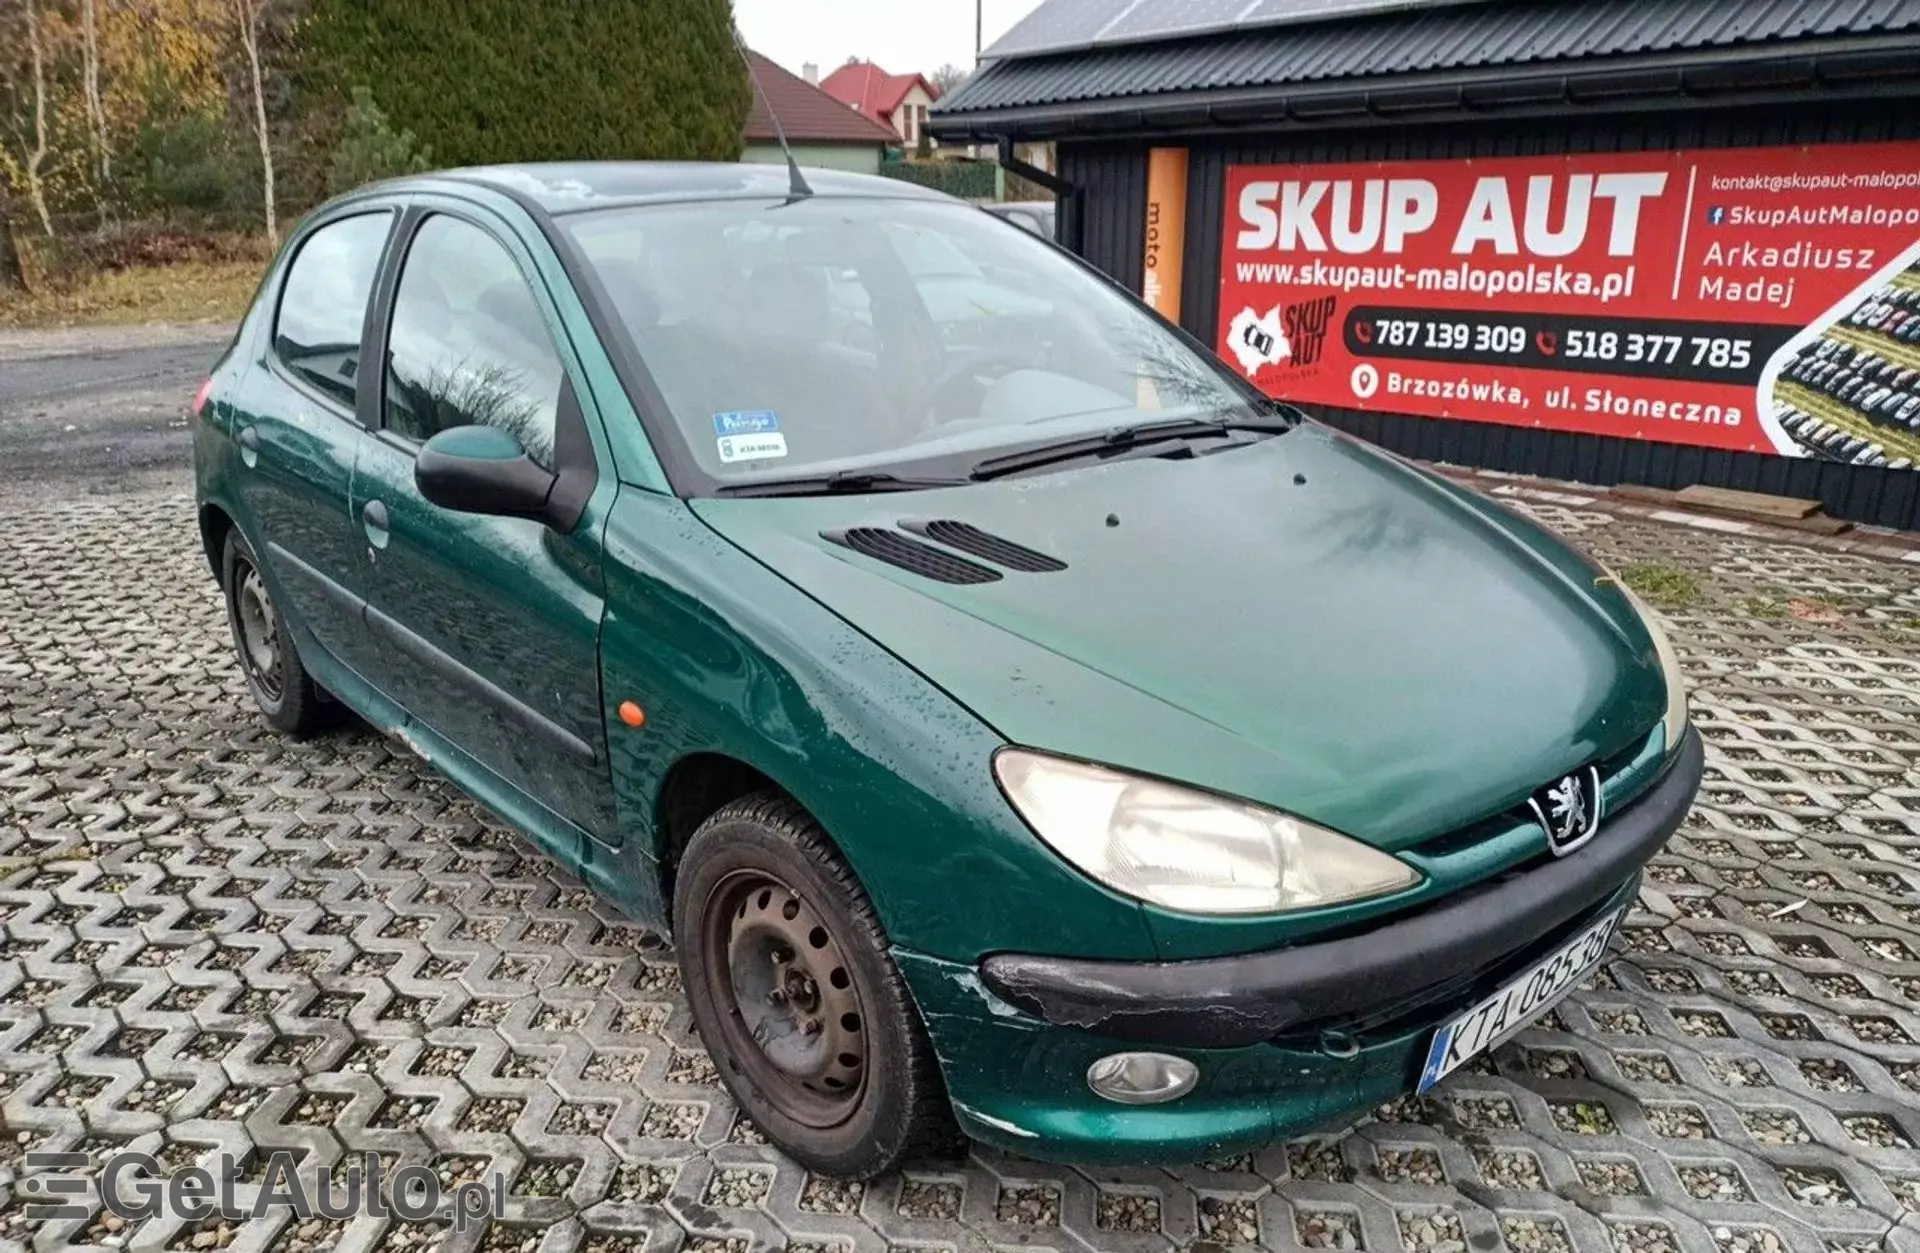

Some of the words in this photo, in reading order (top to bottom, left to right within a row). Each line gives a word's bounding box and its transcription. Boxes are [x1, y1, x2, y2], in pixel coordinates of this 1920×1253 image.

[1236, 178, 1439, 254] SKUP
[1451, 171, 1669, 257] AUT
[1729, 204, 1920, 228] SkupAutMalopo
[1146, 202, 1161, 269] moto
[1702, 241, 1875, 269] Arkadiusz
[1236, 258, 1636, 302] www.skupaut-malopolska.pl
[1699, 276, 1795, 308] Madej
[1285, 295, 1337, 338] SKUP
[1375, 320, 1420, 345] 787
[1425, 321, 1469, 350] 139
[1474, 325, 1527, 353] 309
[1290, 334, 1326, 368] AUT
[1565, 330, 1618, 359] 518
[1624, 334, 1684, 364] 377
[1691, 338, 1752, 369] 785
[1387, 373, 1530, 409] Brzozówka,
[1545, 387, 1576, 409] ul.
[1585, 390, 1742, 426] Słoneczna
[1443, 990, 1513, 1072] KTA
[1519, 918, 1613, 1015] 08538
